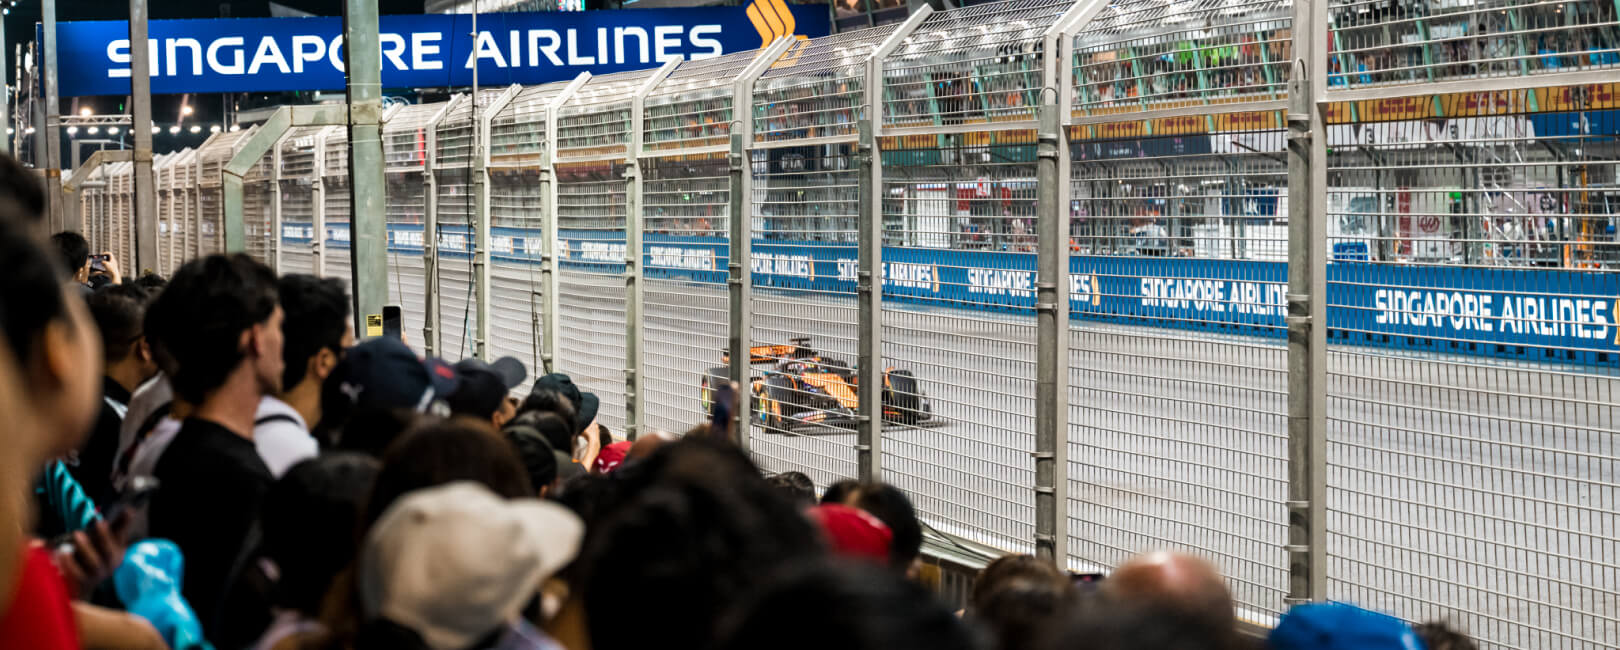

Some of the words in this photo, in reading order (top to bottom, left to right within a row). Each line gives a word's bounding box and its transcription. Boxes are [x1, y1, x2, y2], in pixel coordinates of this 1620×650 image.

[464, 24, 723, 69] AIRLINES
[967, 268, 1031, 298] SINGAPORE
[1140, 277, 1225, 312] SINGAPORE
[1228, 282, 1289, 317] AIRLINE
[1375, 289, 1494, 331] SINGAPORE
[1499, 296, 1609, 340] AIRLINES
